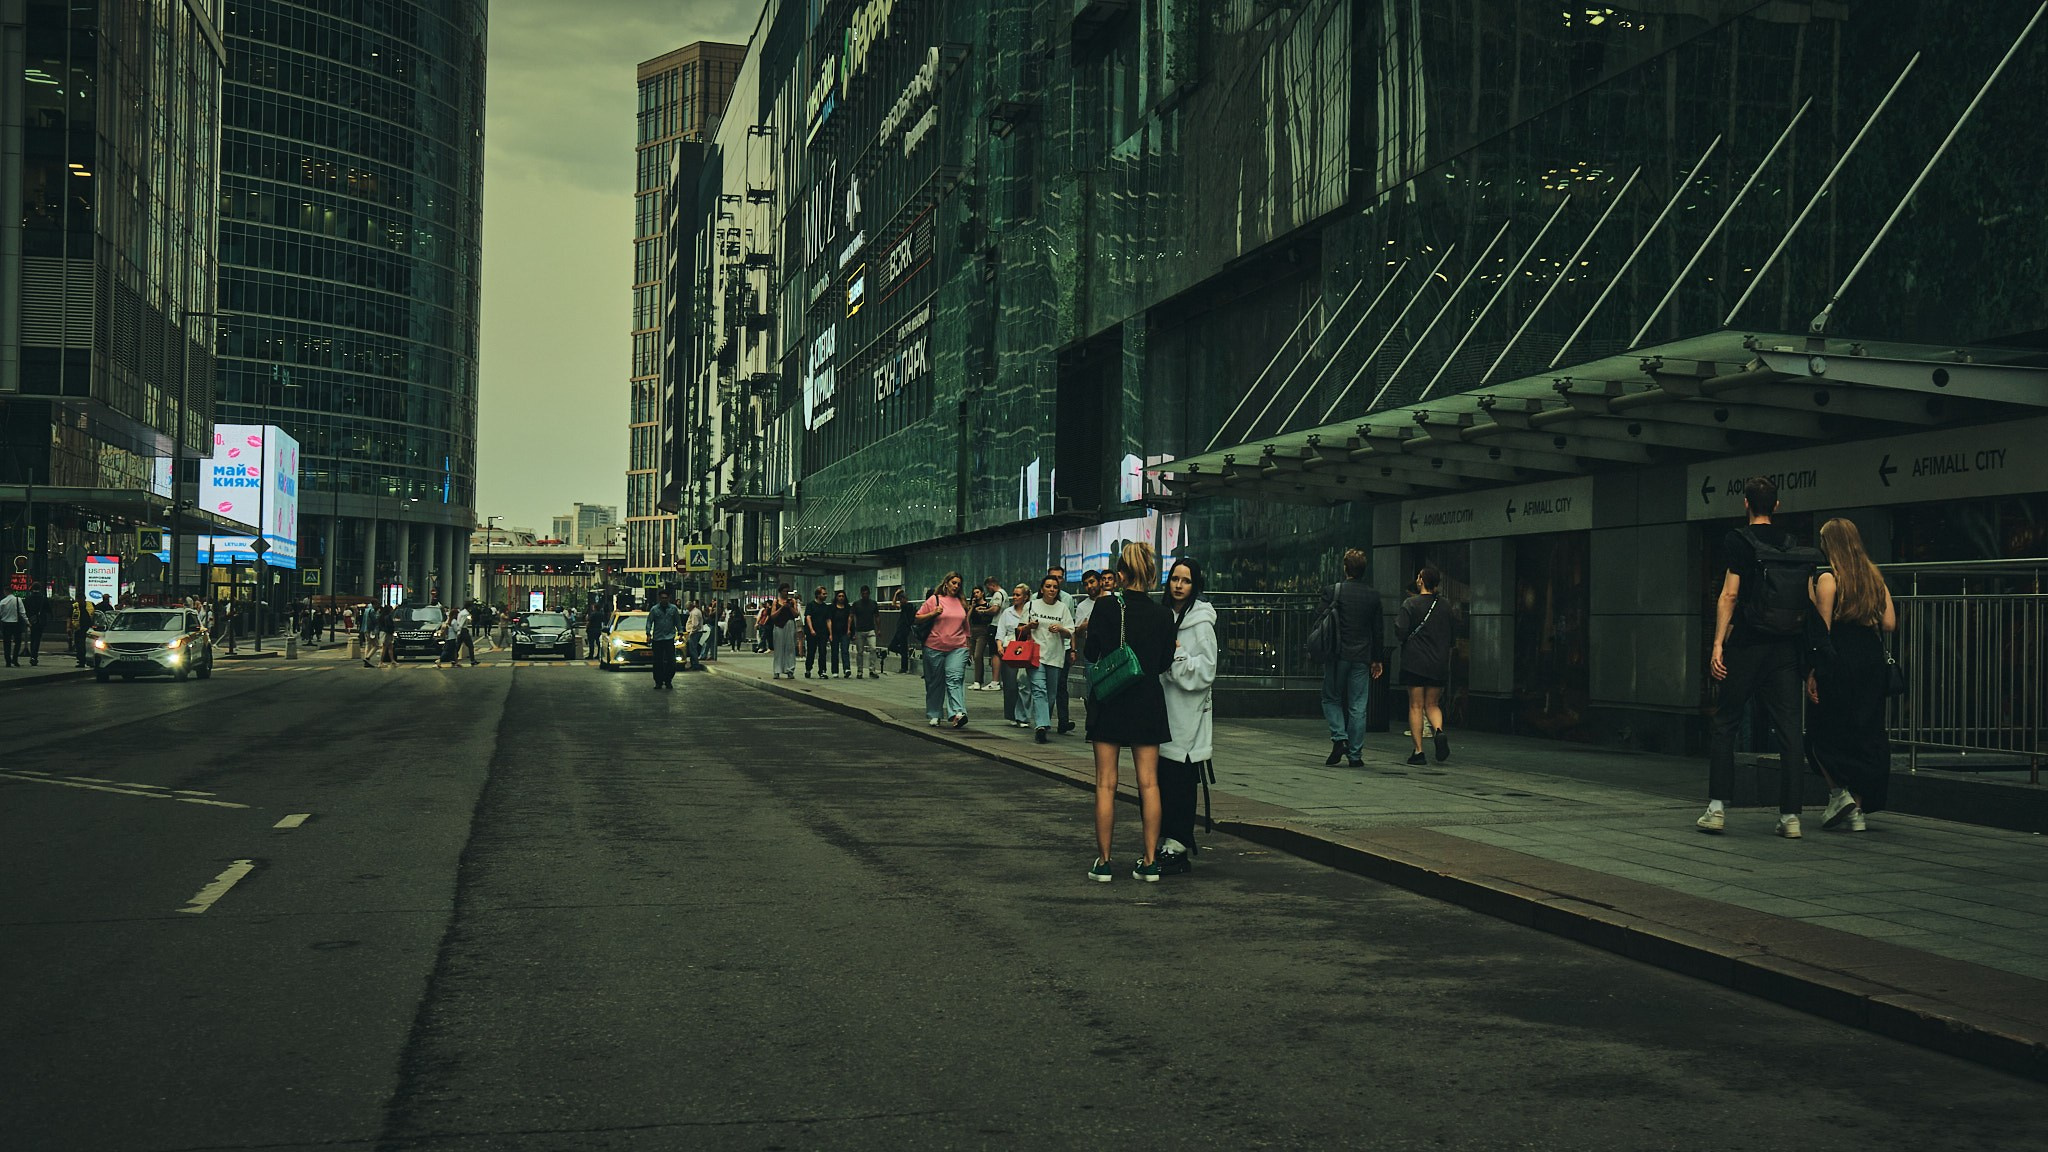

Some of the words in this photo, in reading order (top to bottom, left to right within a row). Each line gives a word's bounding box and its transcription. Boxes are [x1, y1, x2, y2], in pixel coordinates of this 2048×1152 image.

[889, 232, 913, 283] BORK
[873, 336, 927, 403] ТЕХНОПАРК
[213, 463, 246, 476] май
[1912, 453, 1970, 477] AFIMALL
[1975, 447, 2007, 471] CITY
[213, 478, 260, 488] кияж
[1787, 469, 1817, 490] СИТИ
[1523, 499, 1554, 516] AFIMALL
[1555, 496, 1572, 513] CITY
